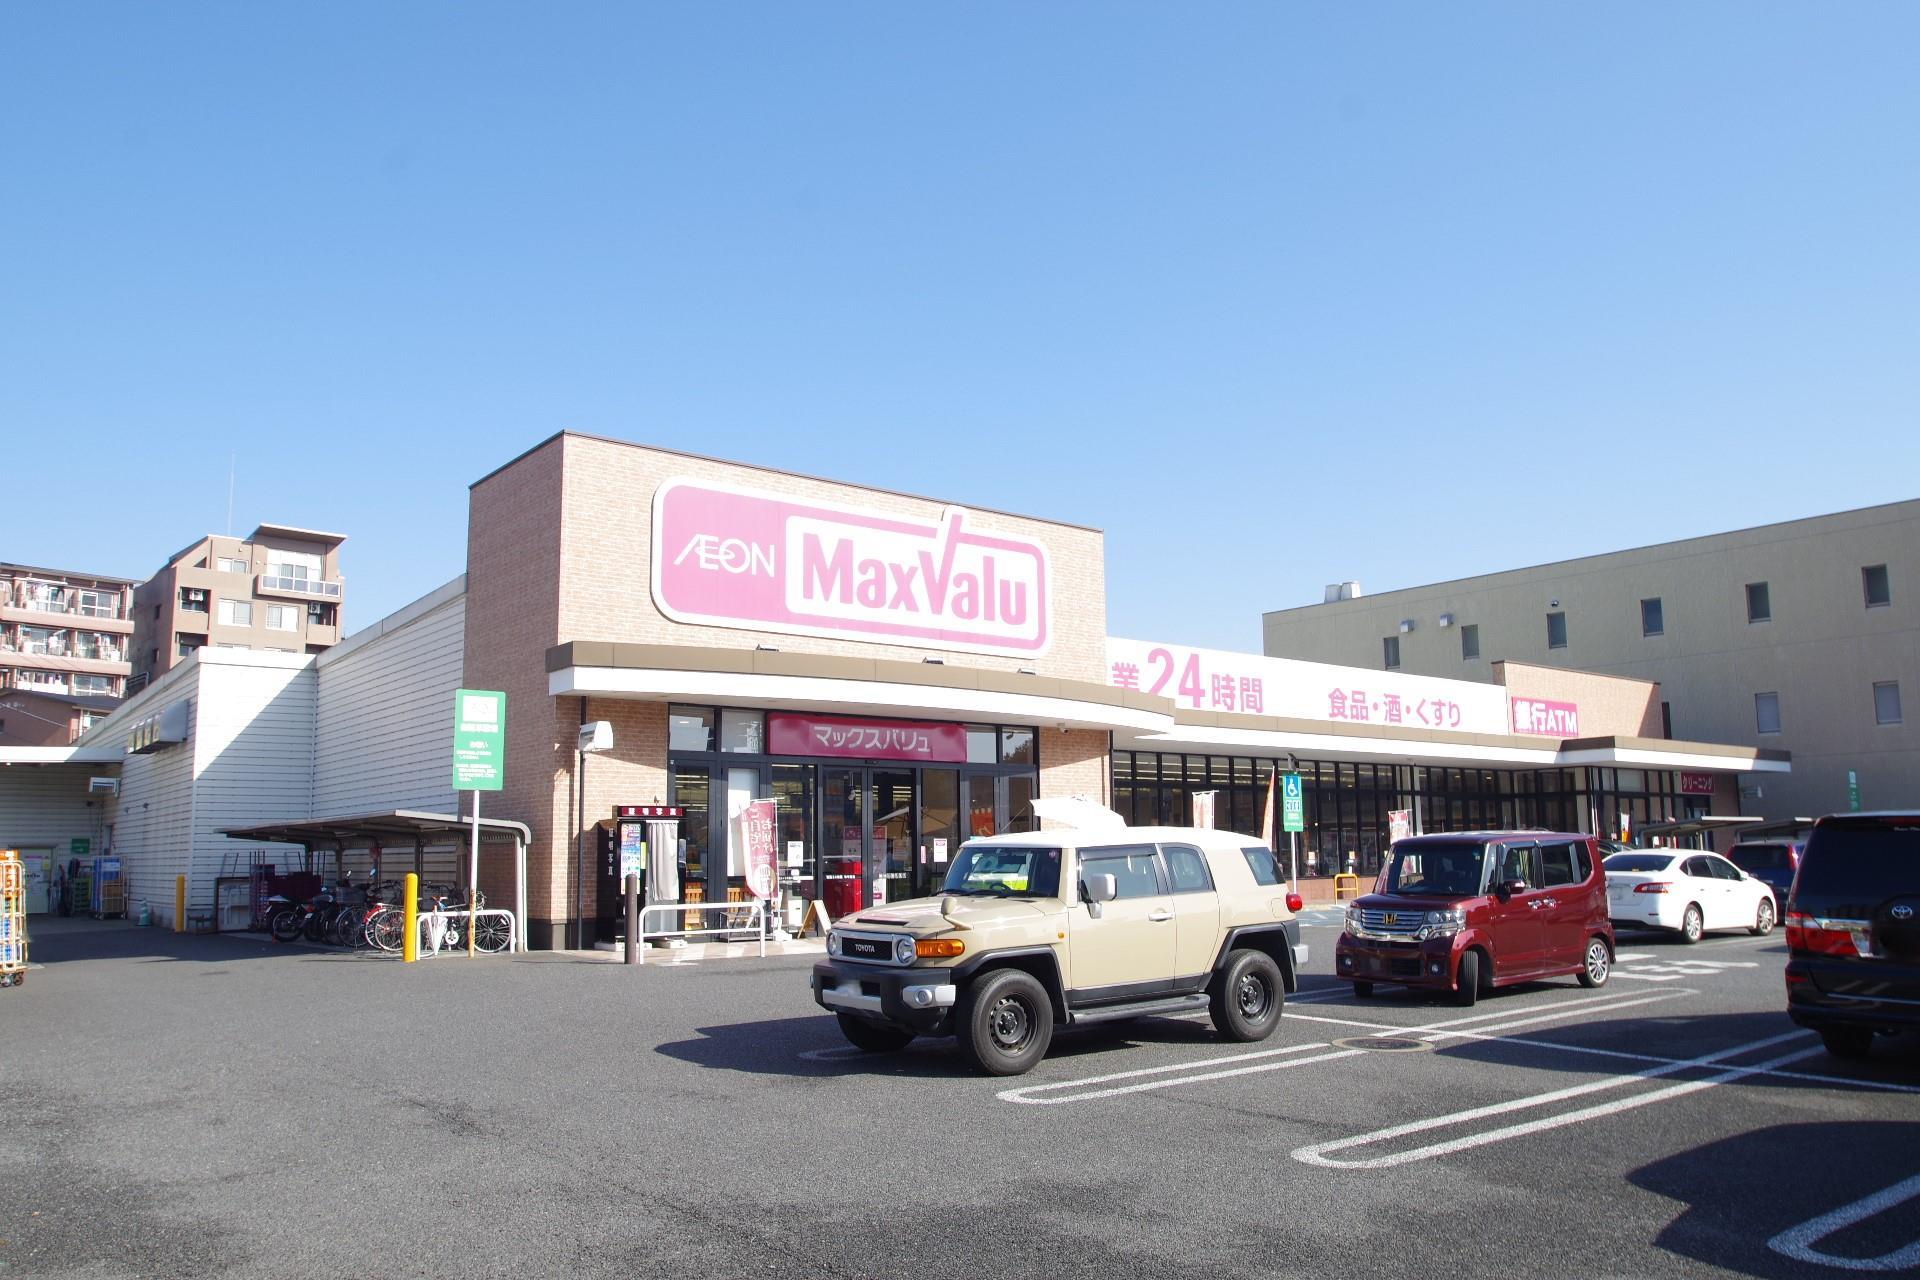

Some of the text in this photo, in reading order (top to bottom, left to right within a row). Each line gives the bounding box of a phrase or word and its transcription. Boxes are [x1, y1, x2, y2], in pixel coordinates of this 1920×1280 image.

[803, 514, 1027, 626] MaxValu
[1328, 687, 1461, 727] 食品・酒・くすり
[813, 725, 931, 752] マックスバリュ
[1682, 775, 1713, 790] クリーニング
[854, 943, 875, 953] TOYOTA
